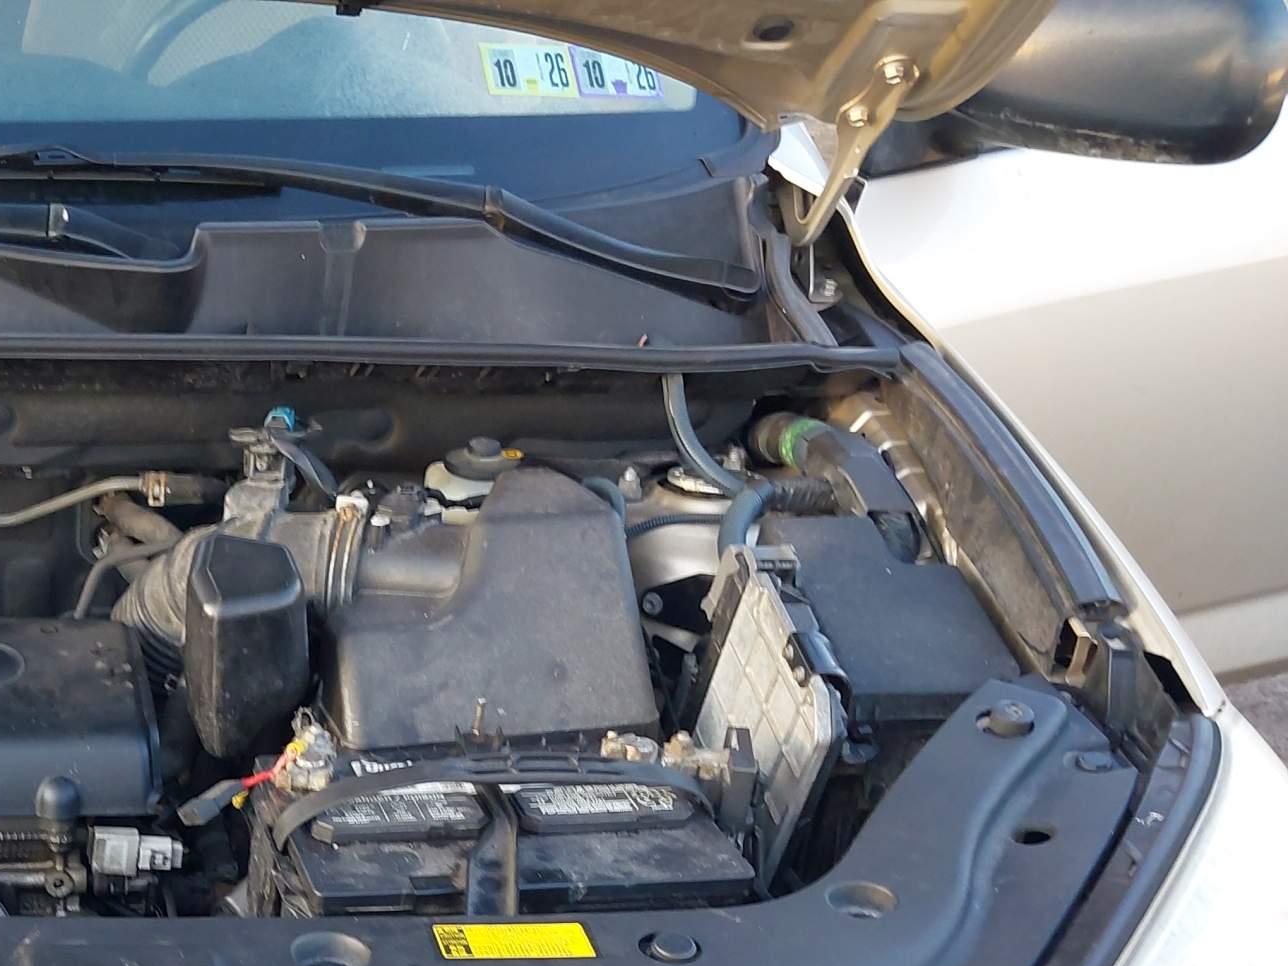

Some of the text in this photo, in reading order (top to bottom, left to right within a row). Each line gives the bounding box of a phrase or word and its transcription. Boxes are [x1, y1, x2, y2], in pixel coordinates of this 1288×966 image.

[494, 52, 570, 88] 10 26
[582, 60, 657, 91] 10 26
